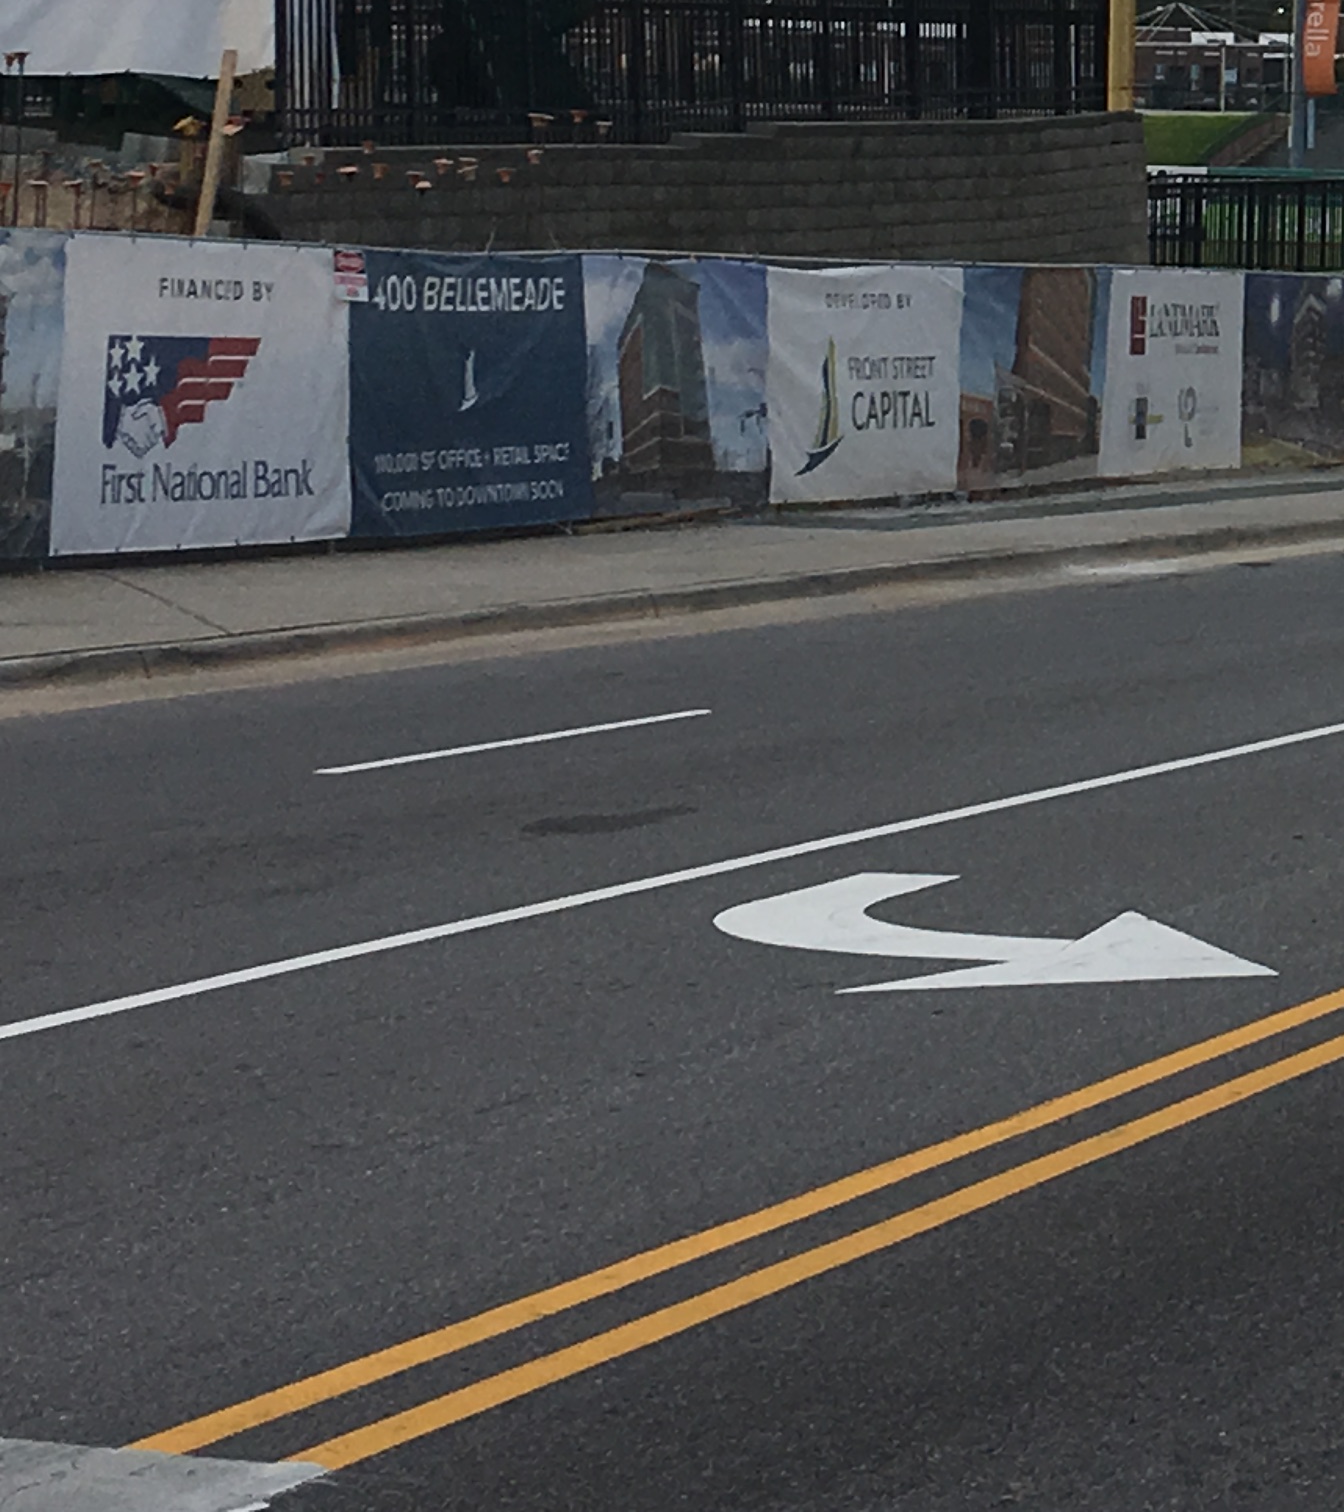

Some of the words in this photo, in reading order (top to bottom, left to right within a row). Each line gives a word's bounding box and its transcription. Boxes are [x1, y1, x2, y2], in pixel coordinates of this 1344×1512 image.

[158, 277, 244, 301] FINANCED
[252, 280, 275, 302] BY
[372, 274, 417, 312] 400
[422, 275, 565, 312] BELLEMEADE
[847, 355, 889, 381] FRONT
[892, 355, 936, 380] STREET
[851, 390, 936, 431] CAPITAL
[437, 447, 483, 470] OFFICE
[492, 445, 531, 467] RETAIL
[533, 442, 570, 464] SPACE
[101, 463, 146, 504] First
[151, 460, 248, 503] National
[253, 459, 315, 499] Bank
[381, 488, 434, 512] COMING
[436, 487, 454, 508] TO
[455, 482, 531, 507] DOWNTOWN
[531, 479, 564, 501] SOON
